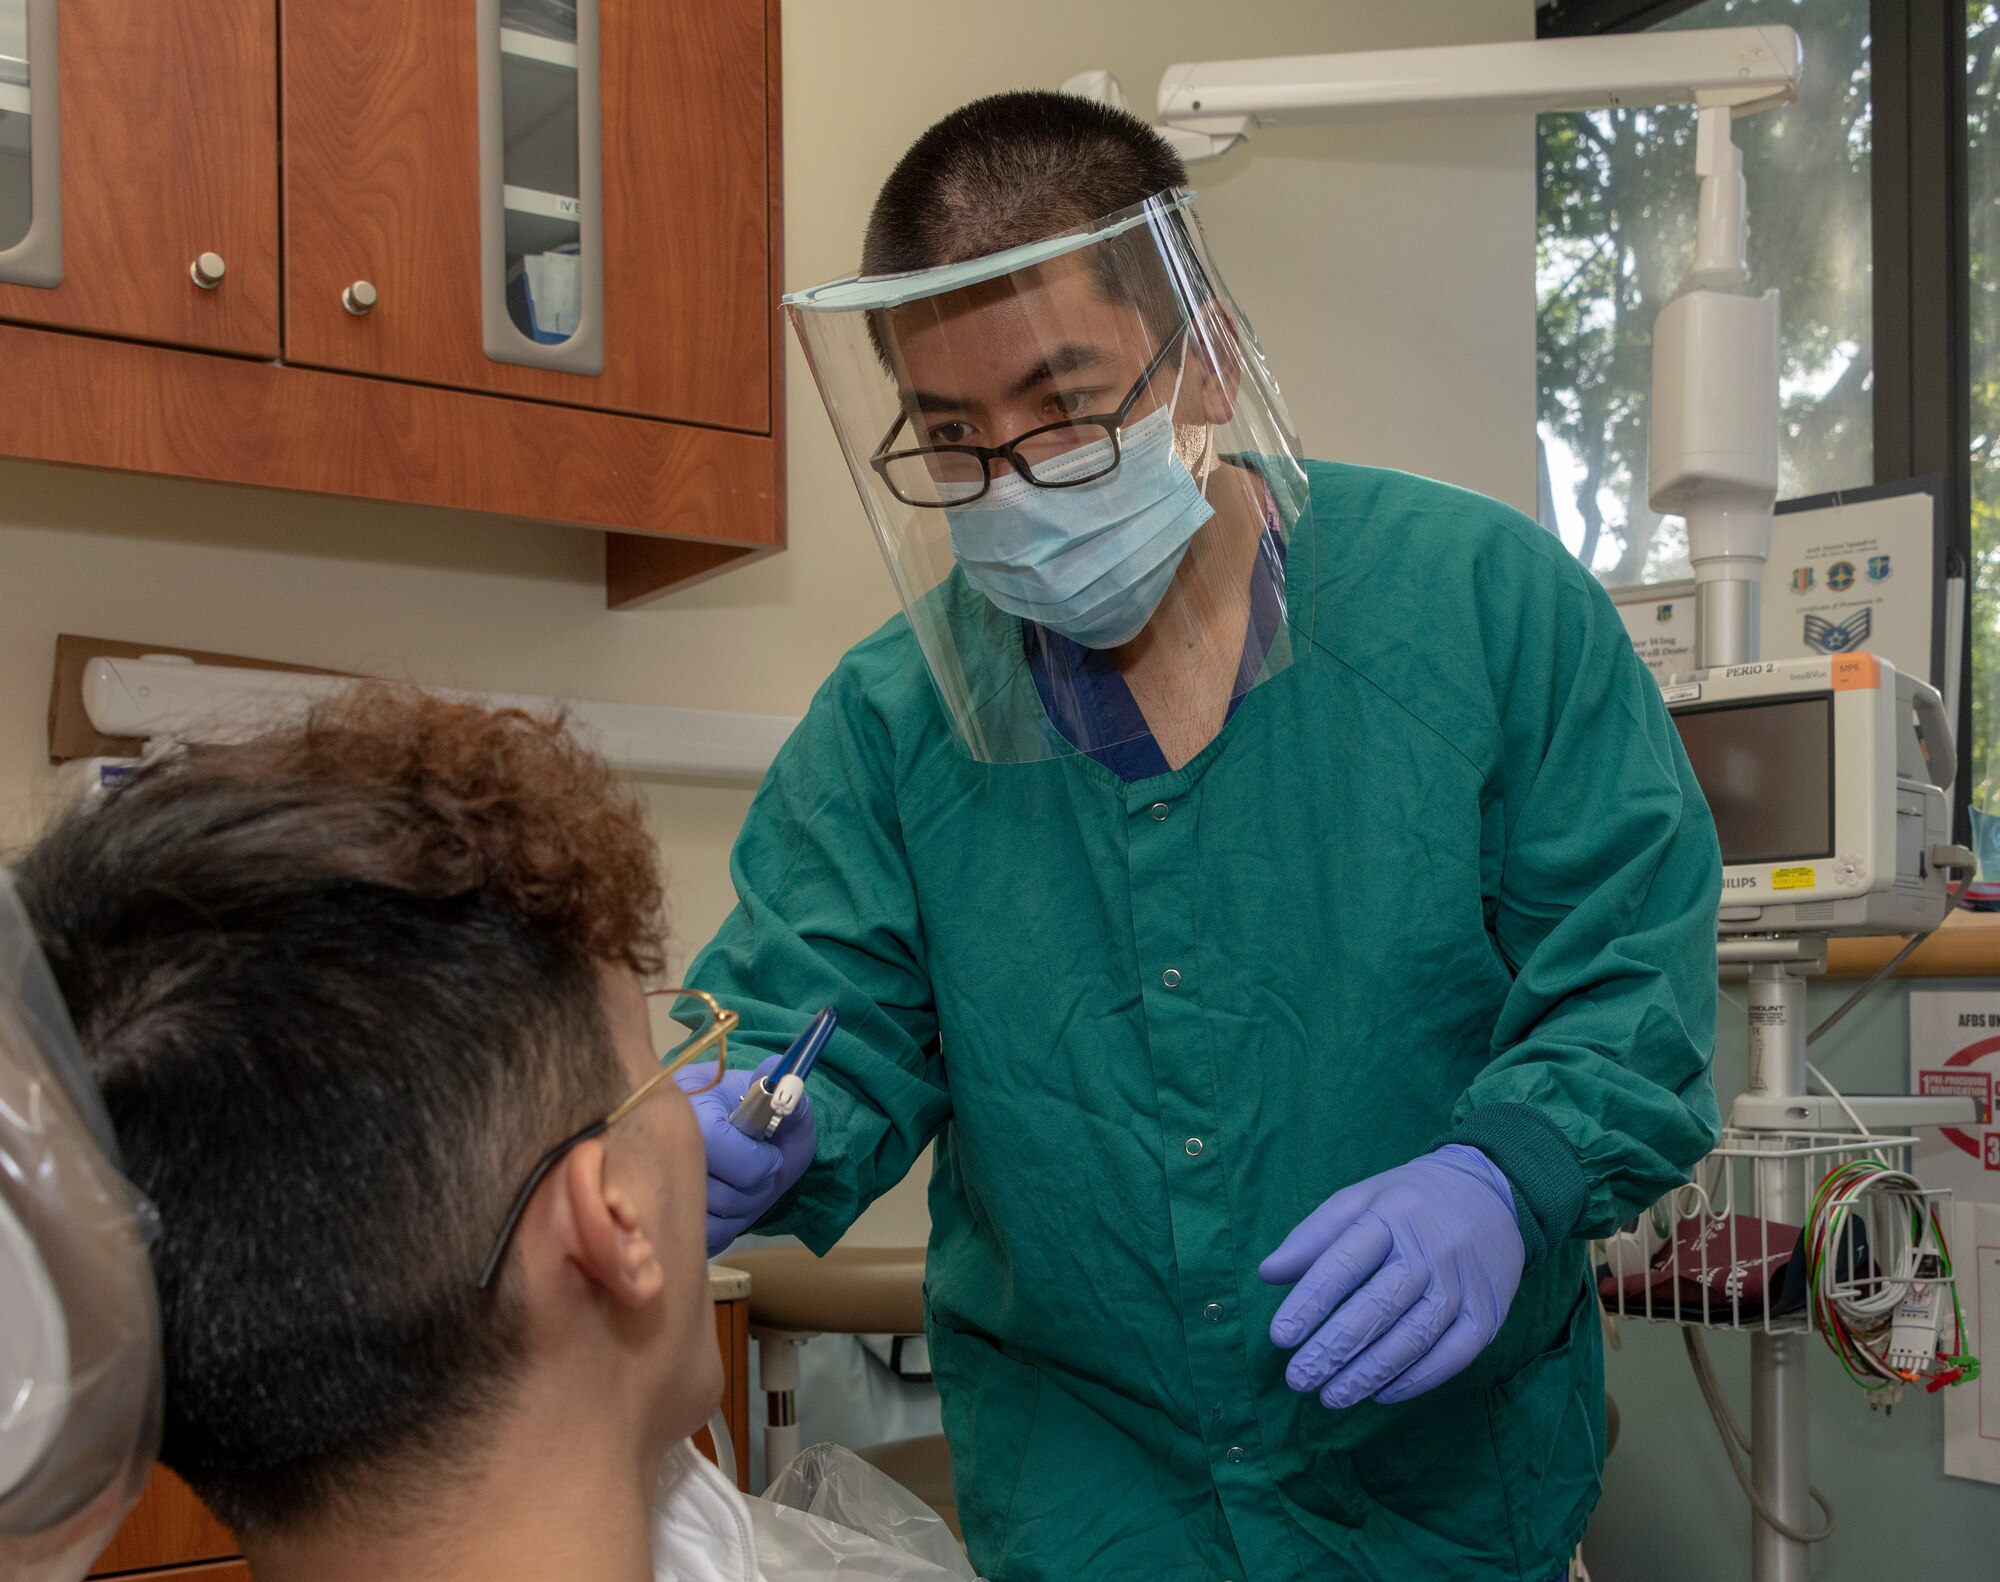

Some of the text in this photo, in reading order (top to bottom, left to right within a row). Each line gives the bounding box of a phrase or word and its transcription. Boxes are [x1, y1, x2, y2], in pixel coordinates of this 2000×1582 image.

[1726, 663, 1773, 678] PERIO 2
[1790, 670, 1827, 681] IntelliVue
[1958, 1014, 1986, 1028] AFDS
[1930, 1086, 1988, 1097] VERIFICATION
[1987, 1136, 2000, 1166] 3
